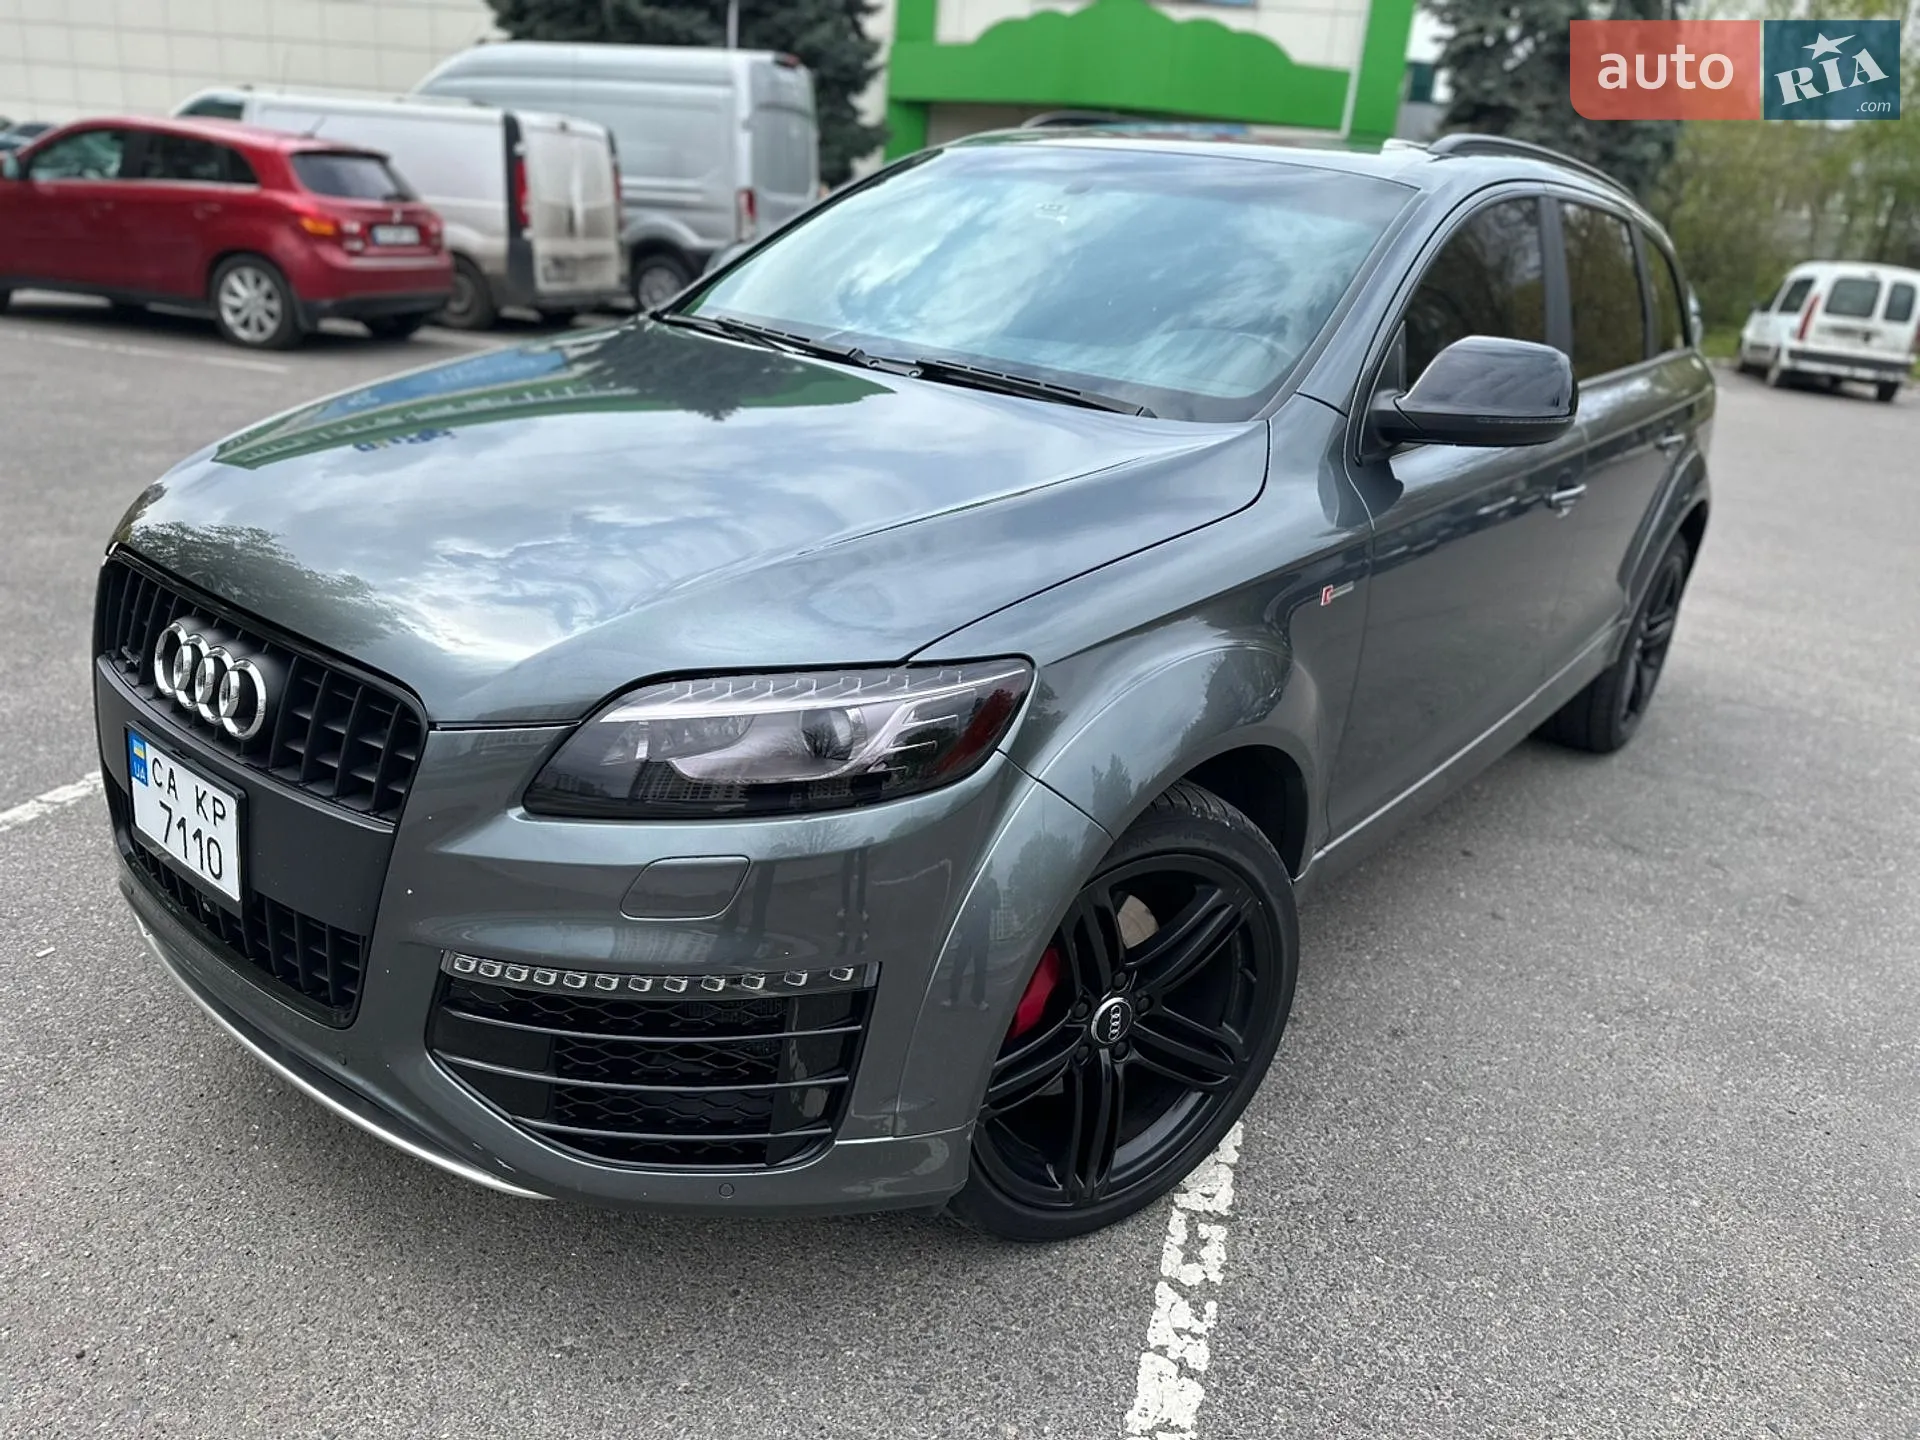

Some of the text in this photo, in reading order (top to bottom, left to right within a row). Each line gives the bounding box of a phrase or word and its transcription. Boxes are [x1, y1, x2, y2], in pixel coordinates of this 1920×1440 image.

[133, 761, 147, 783] UA
[152, 757, 226, 827] CA KP
[159, 800, 223, 880] 7110
